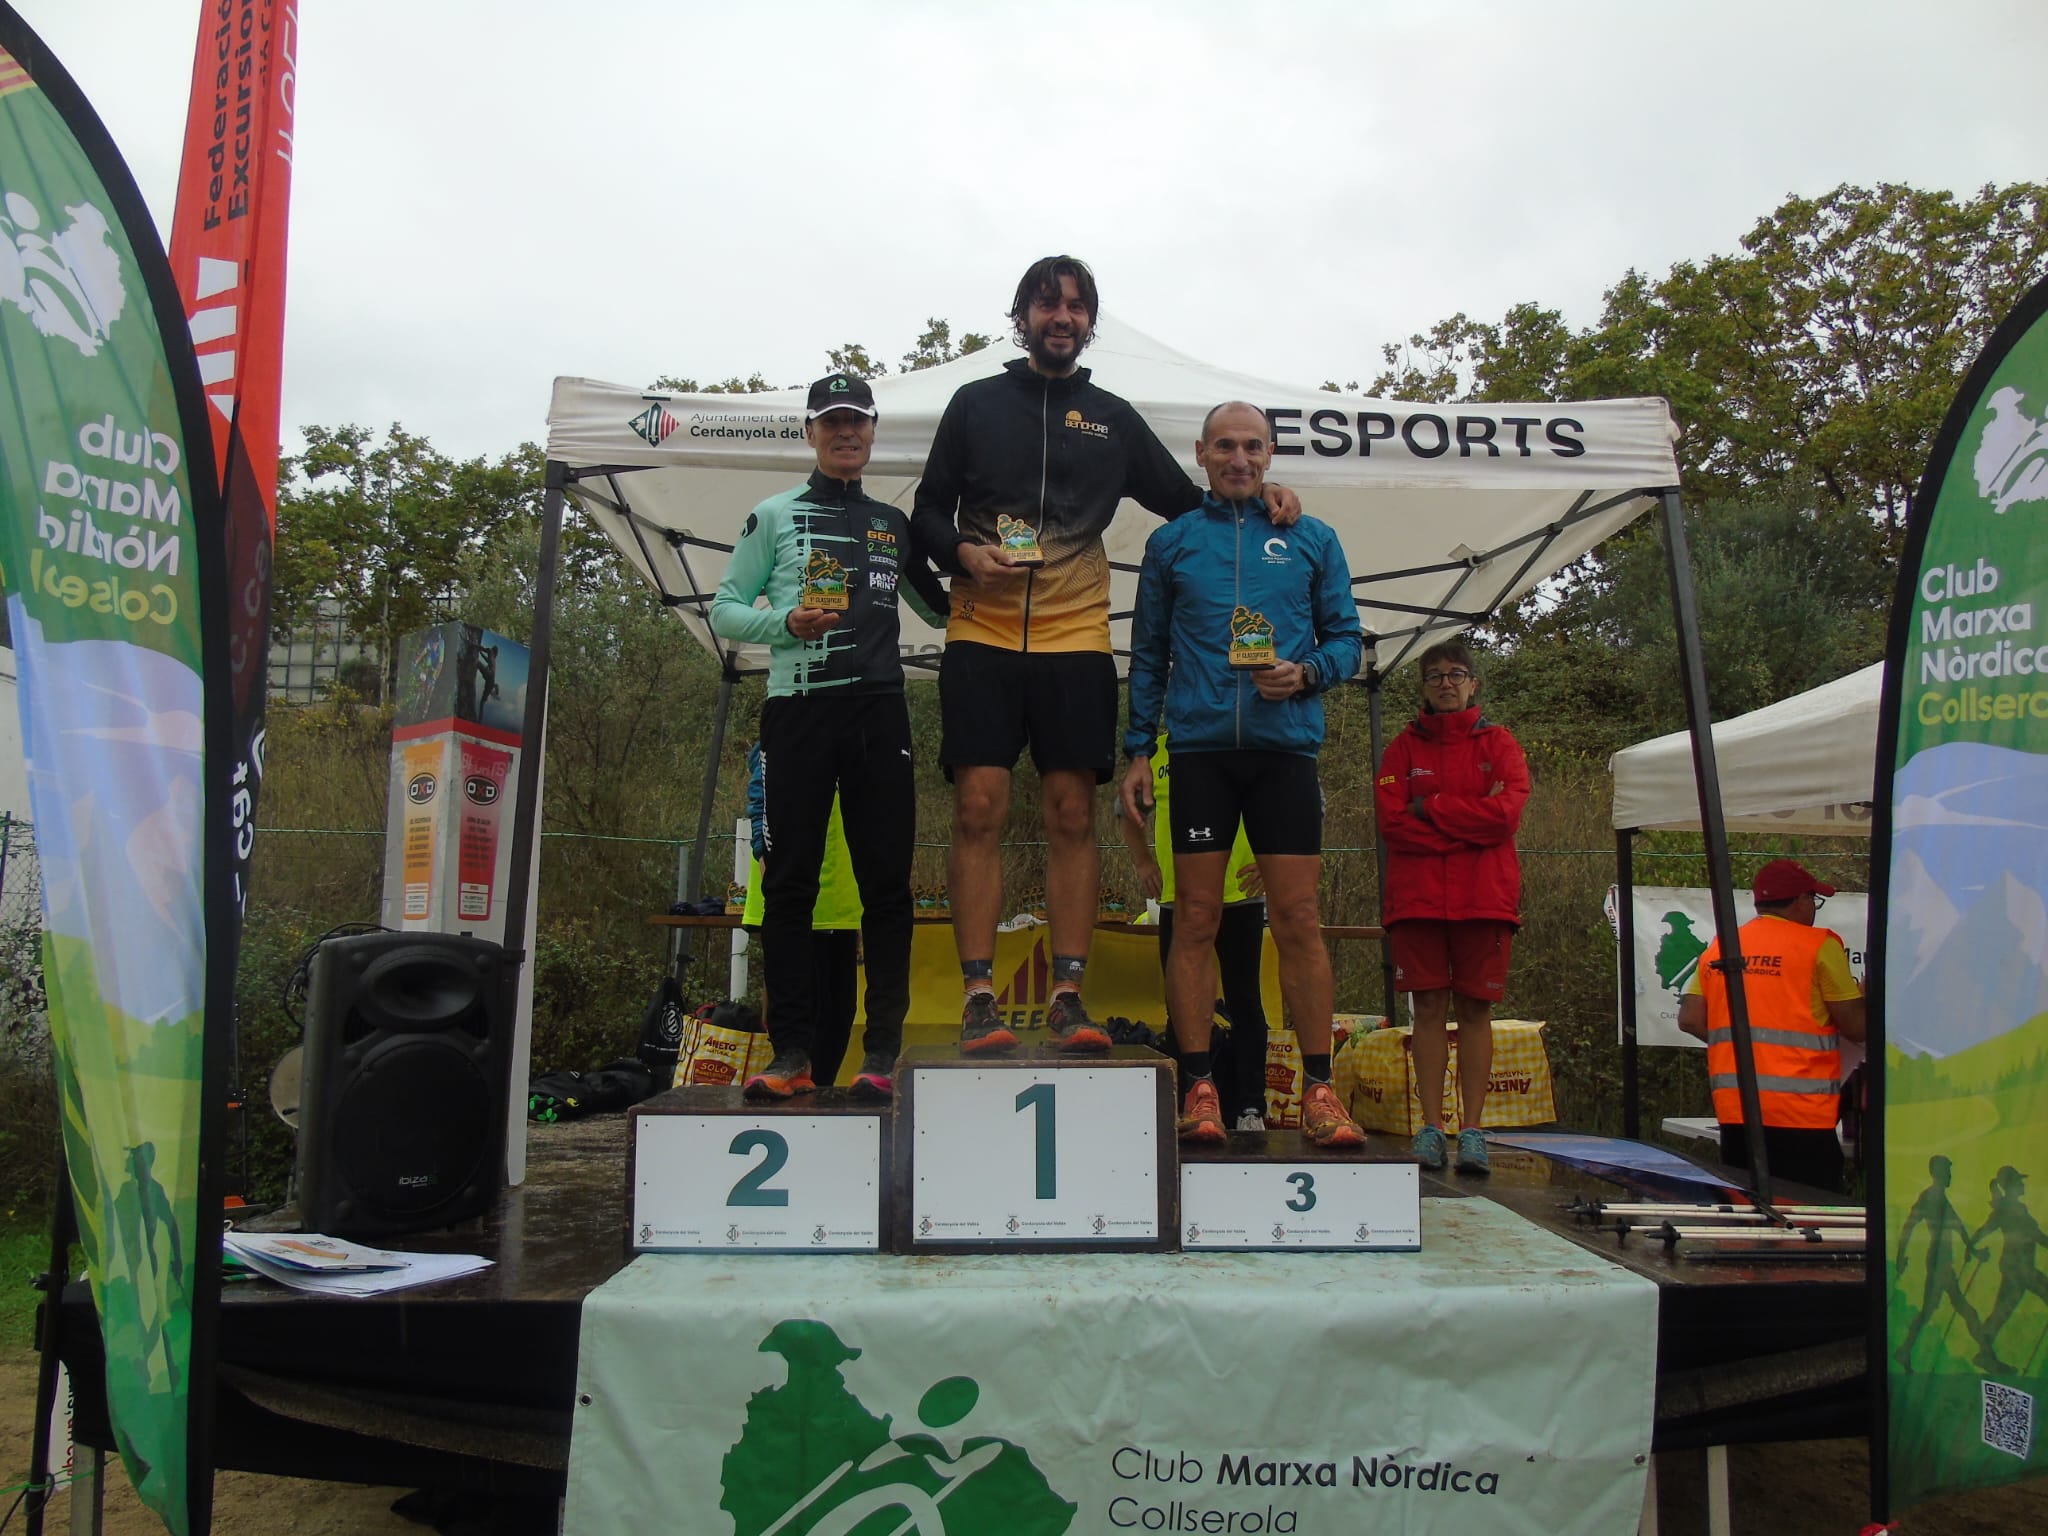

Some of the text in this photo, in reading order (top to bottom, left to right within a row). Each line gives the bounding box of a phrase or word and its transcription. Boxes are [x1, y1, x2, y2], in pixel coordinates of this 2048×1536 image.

[690, 426, 805, 440] Cerdanyola del
[691, 413, 774, 424] Ajuntament
[1266, 409, 1586, 458] ESPORTS
[1921, 558, 1998, 602] Club
[1922, 603, 2031, 644] Marxa
[467, 782, 495, 797] OXD
[704, 1035, 737, 1051] ANETO
[701, 1062, 728, 1073] SOLO
[1016, 1084, 1056, 1199] 1
[727, 1129, 789, 1206] 2
[1285, 1171, 1317, 1212] 3
[1112, 1447, 1499, 1494] Club Marxa Nòrdica
[1108, 1496, 1297, 1534] Collserola
